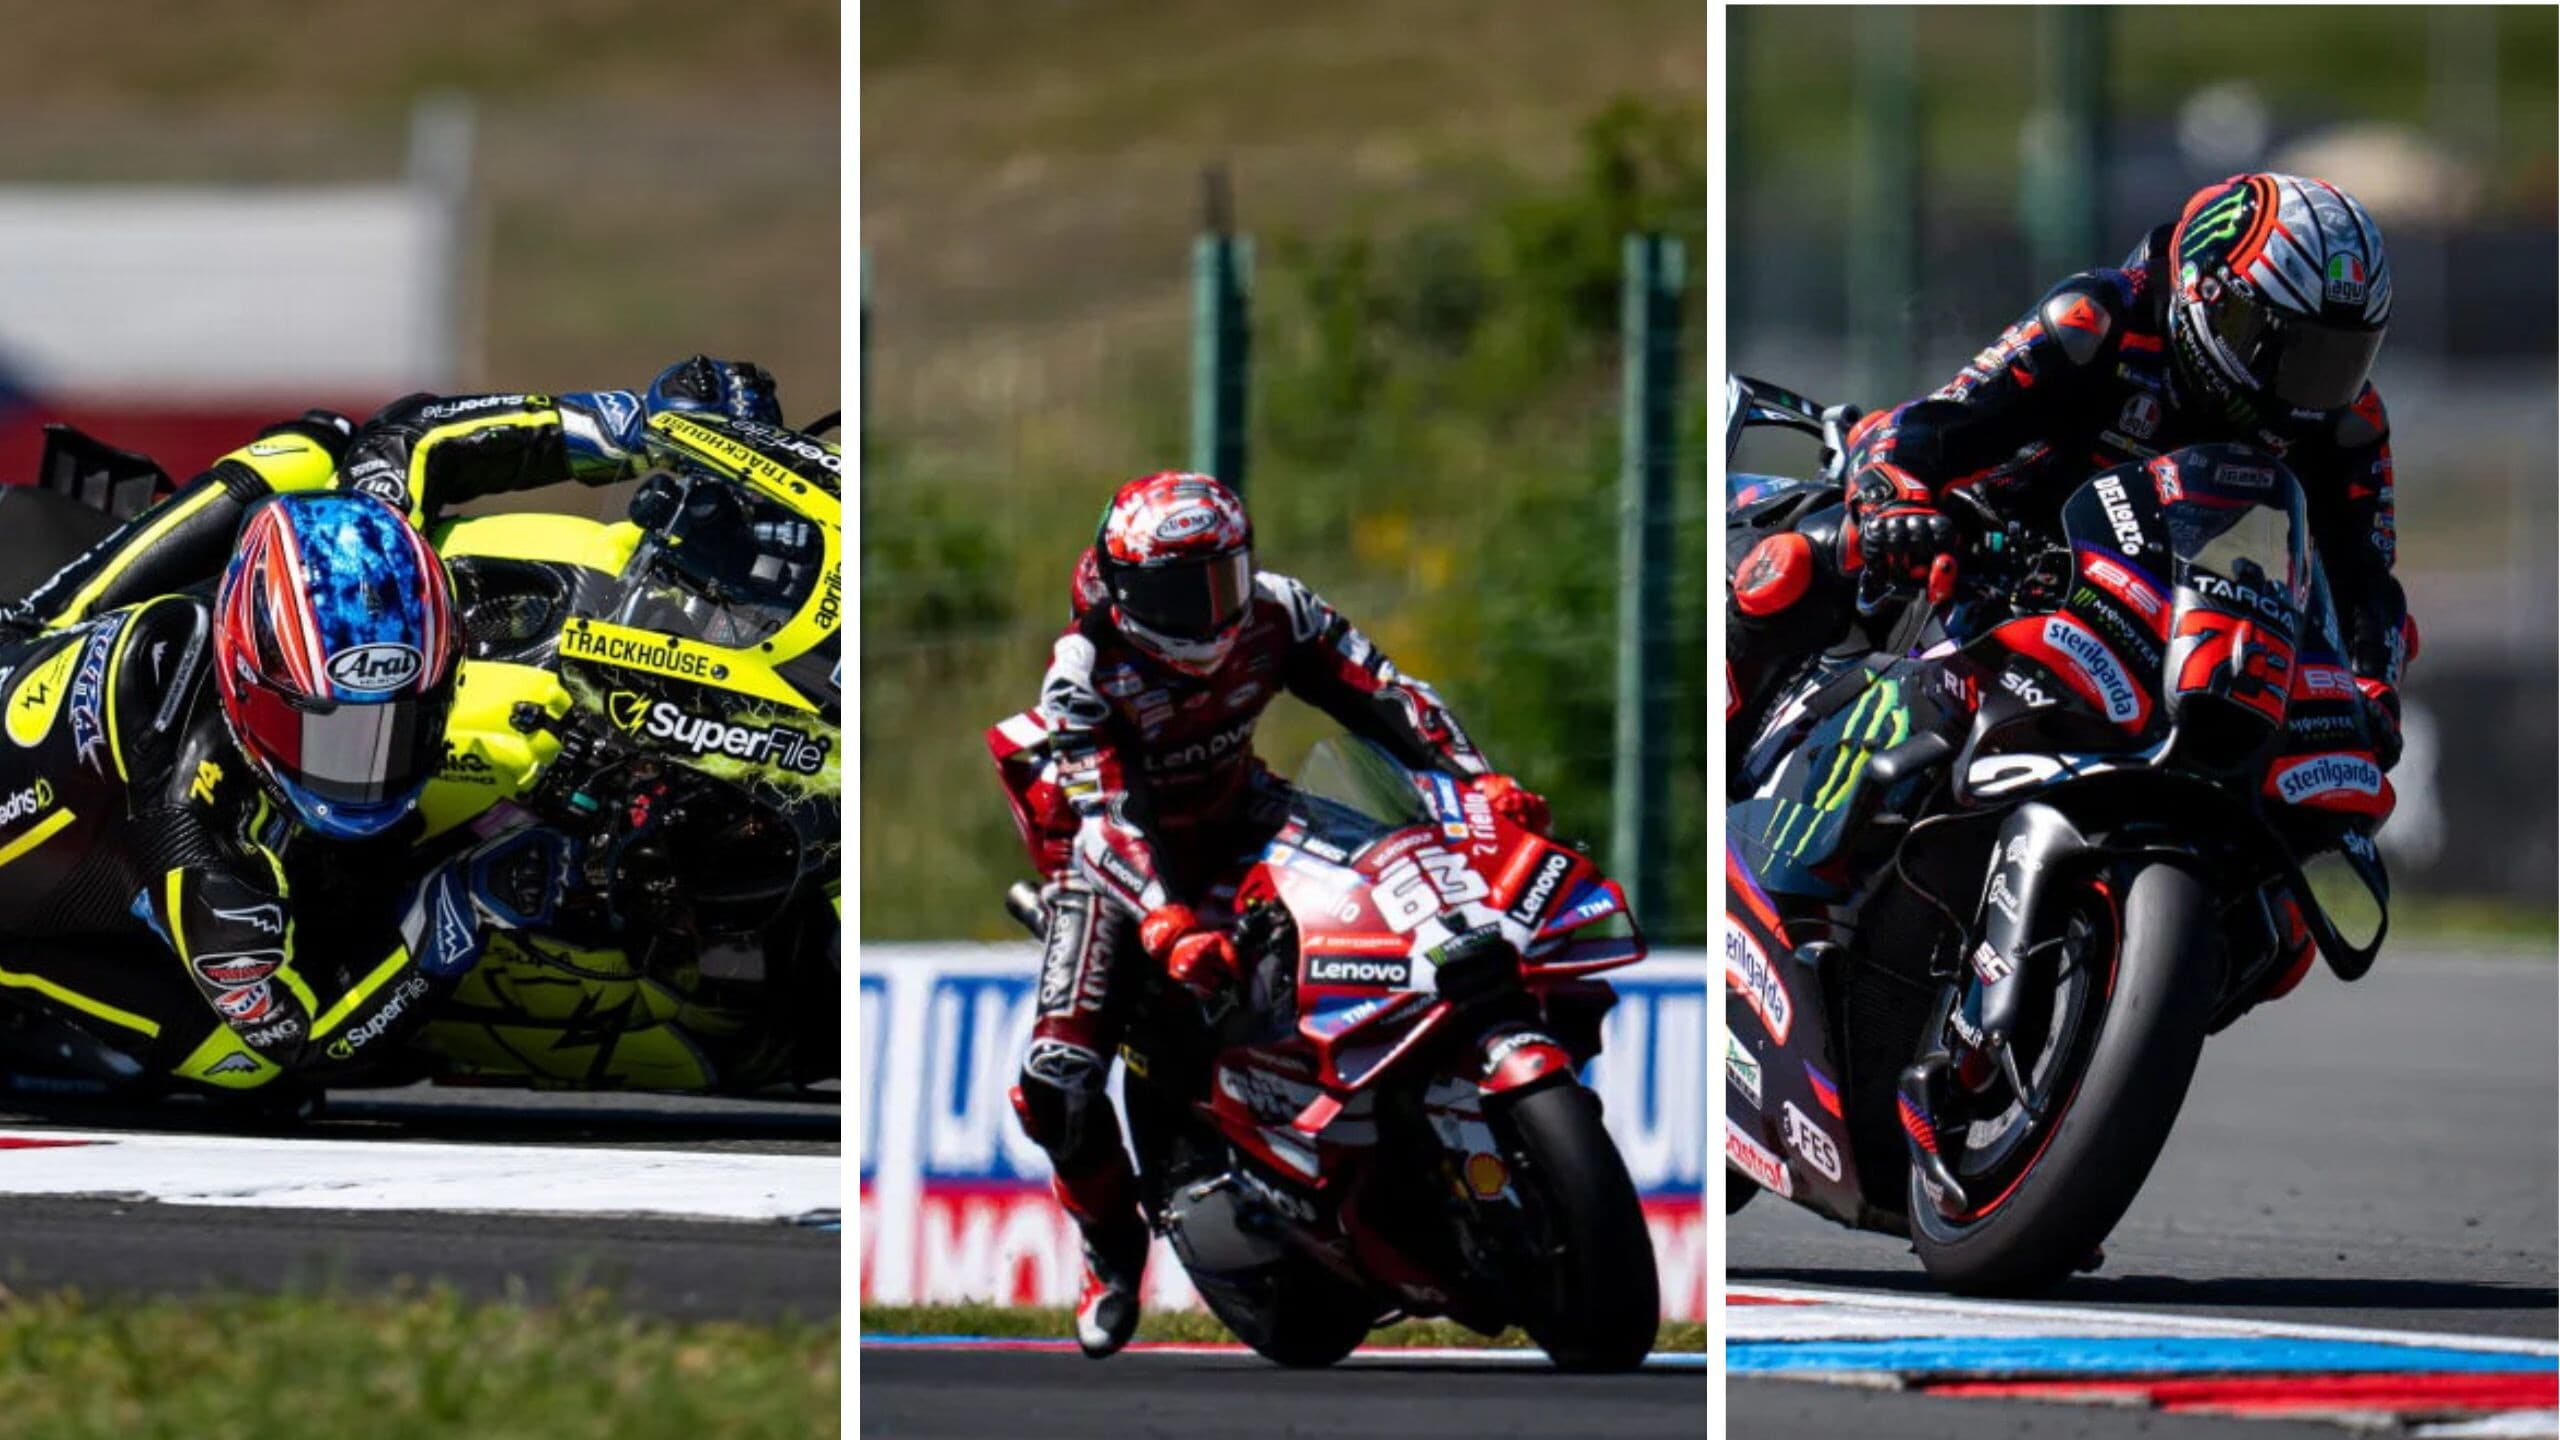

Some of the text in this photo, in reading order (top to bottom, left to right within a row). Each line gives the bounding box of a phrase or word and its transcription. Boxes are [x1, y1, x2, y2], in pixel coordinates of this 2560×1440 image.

[660, 413, 786, 486] TRACKHOUSE
[335, 648, 412, 678] Arai
[565, 628, 710, 678] TRACKHOUSE
[2050, 623, 2134, 716] sterilgarda
[2000, 671, 2057, 707] sky
[647, 702, 822, 772] SuperFile
[2284, 758, 2378, 796] sterilgarda
[1511, 853, 1568, 925] Lenovo
[1577, 898, 1615, 919] TIM
[1310, 958, 1407, 983] Lenovo
[1340, 1001, 1377, 1025] TIM
[1800, 1121, 1837, 1174] FES
